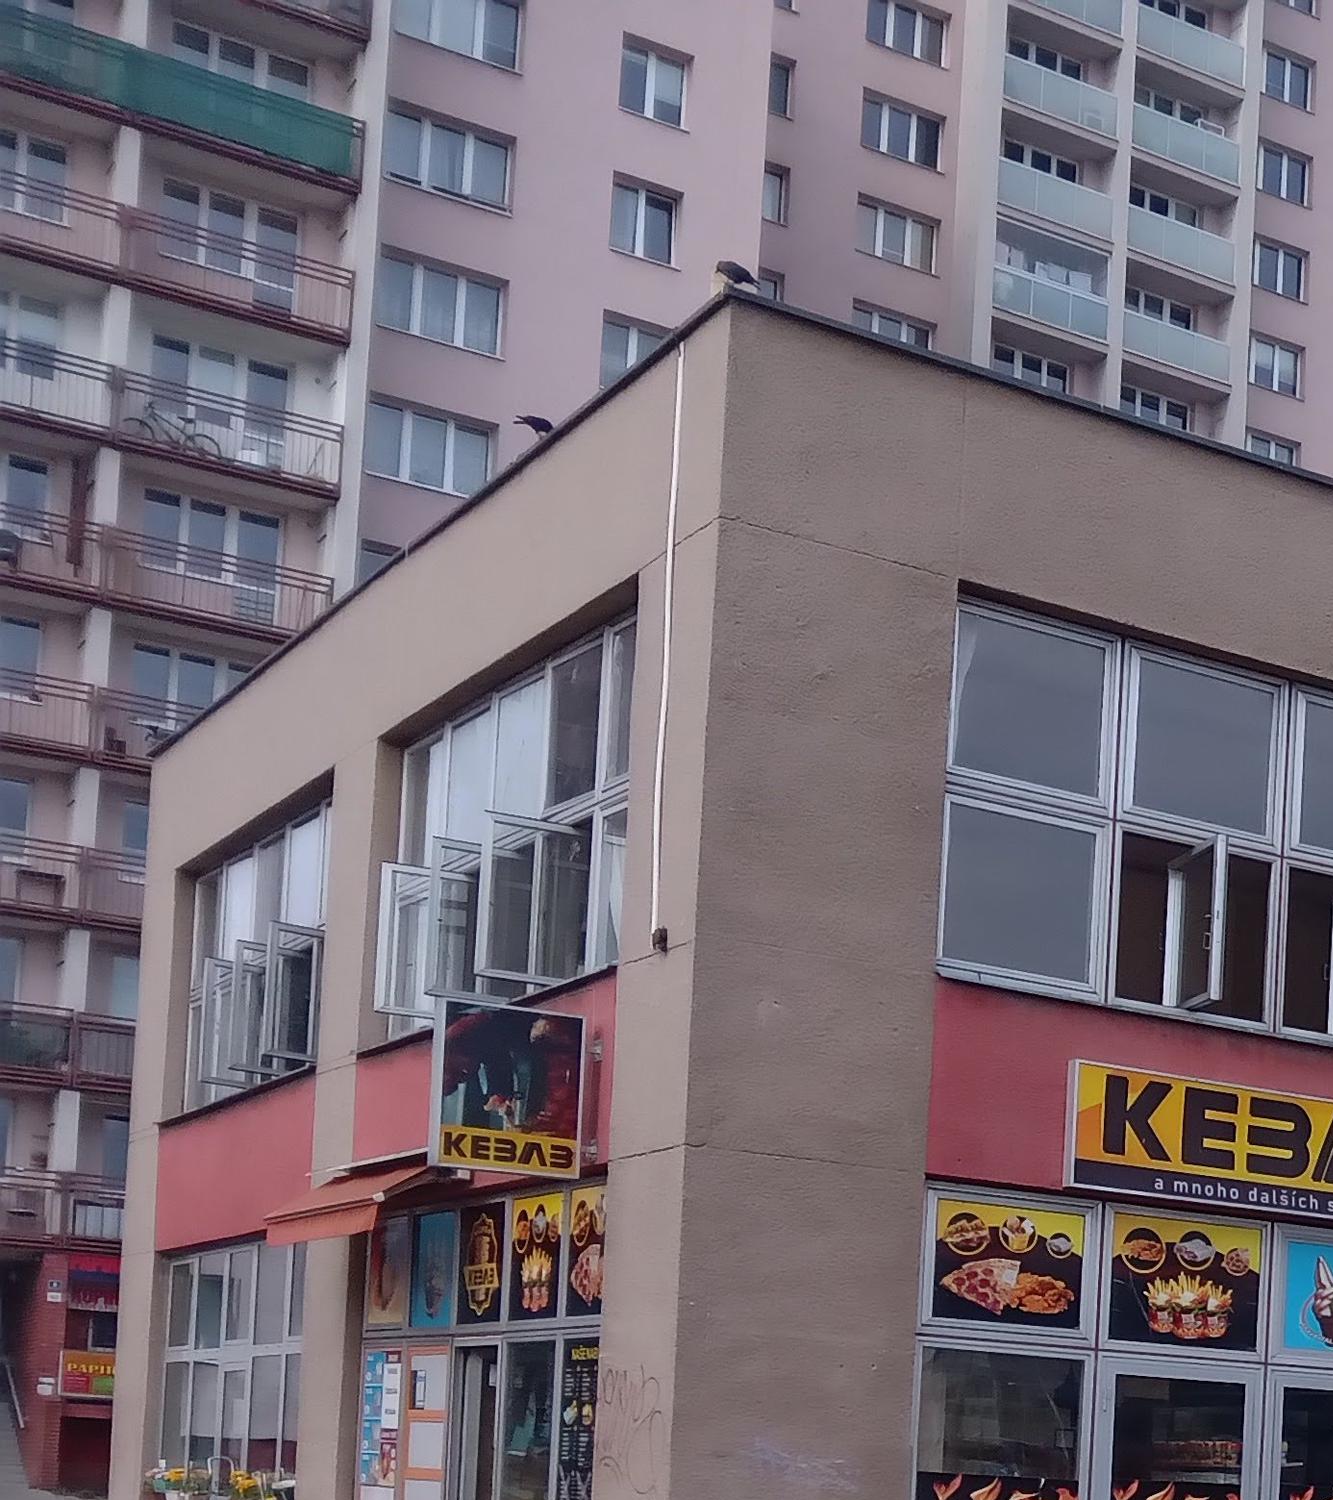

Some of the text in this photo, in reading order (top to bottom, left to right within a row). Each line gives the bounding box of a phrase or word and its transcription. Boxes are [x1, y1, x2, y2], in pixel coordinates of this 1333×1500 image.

[443, 1131, 573, 1169] KEBAB
[1154, 1178, 1164, 1190] a
[1173, 1180, 1239, 1200] mnoho
[1248, 1187, 1319, 1210] dalších
